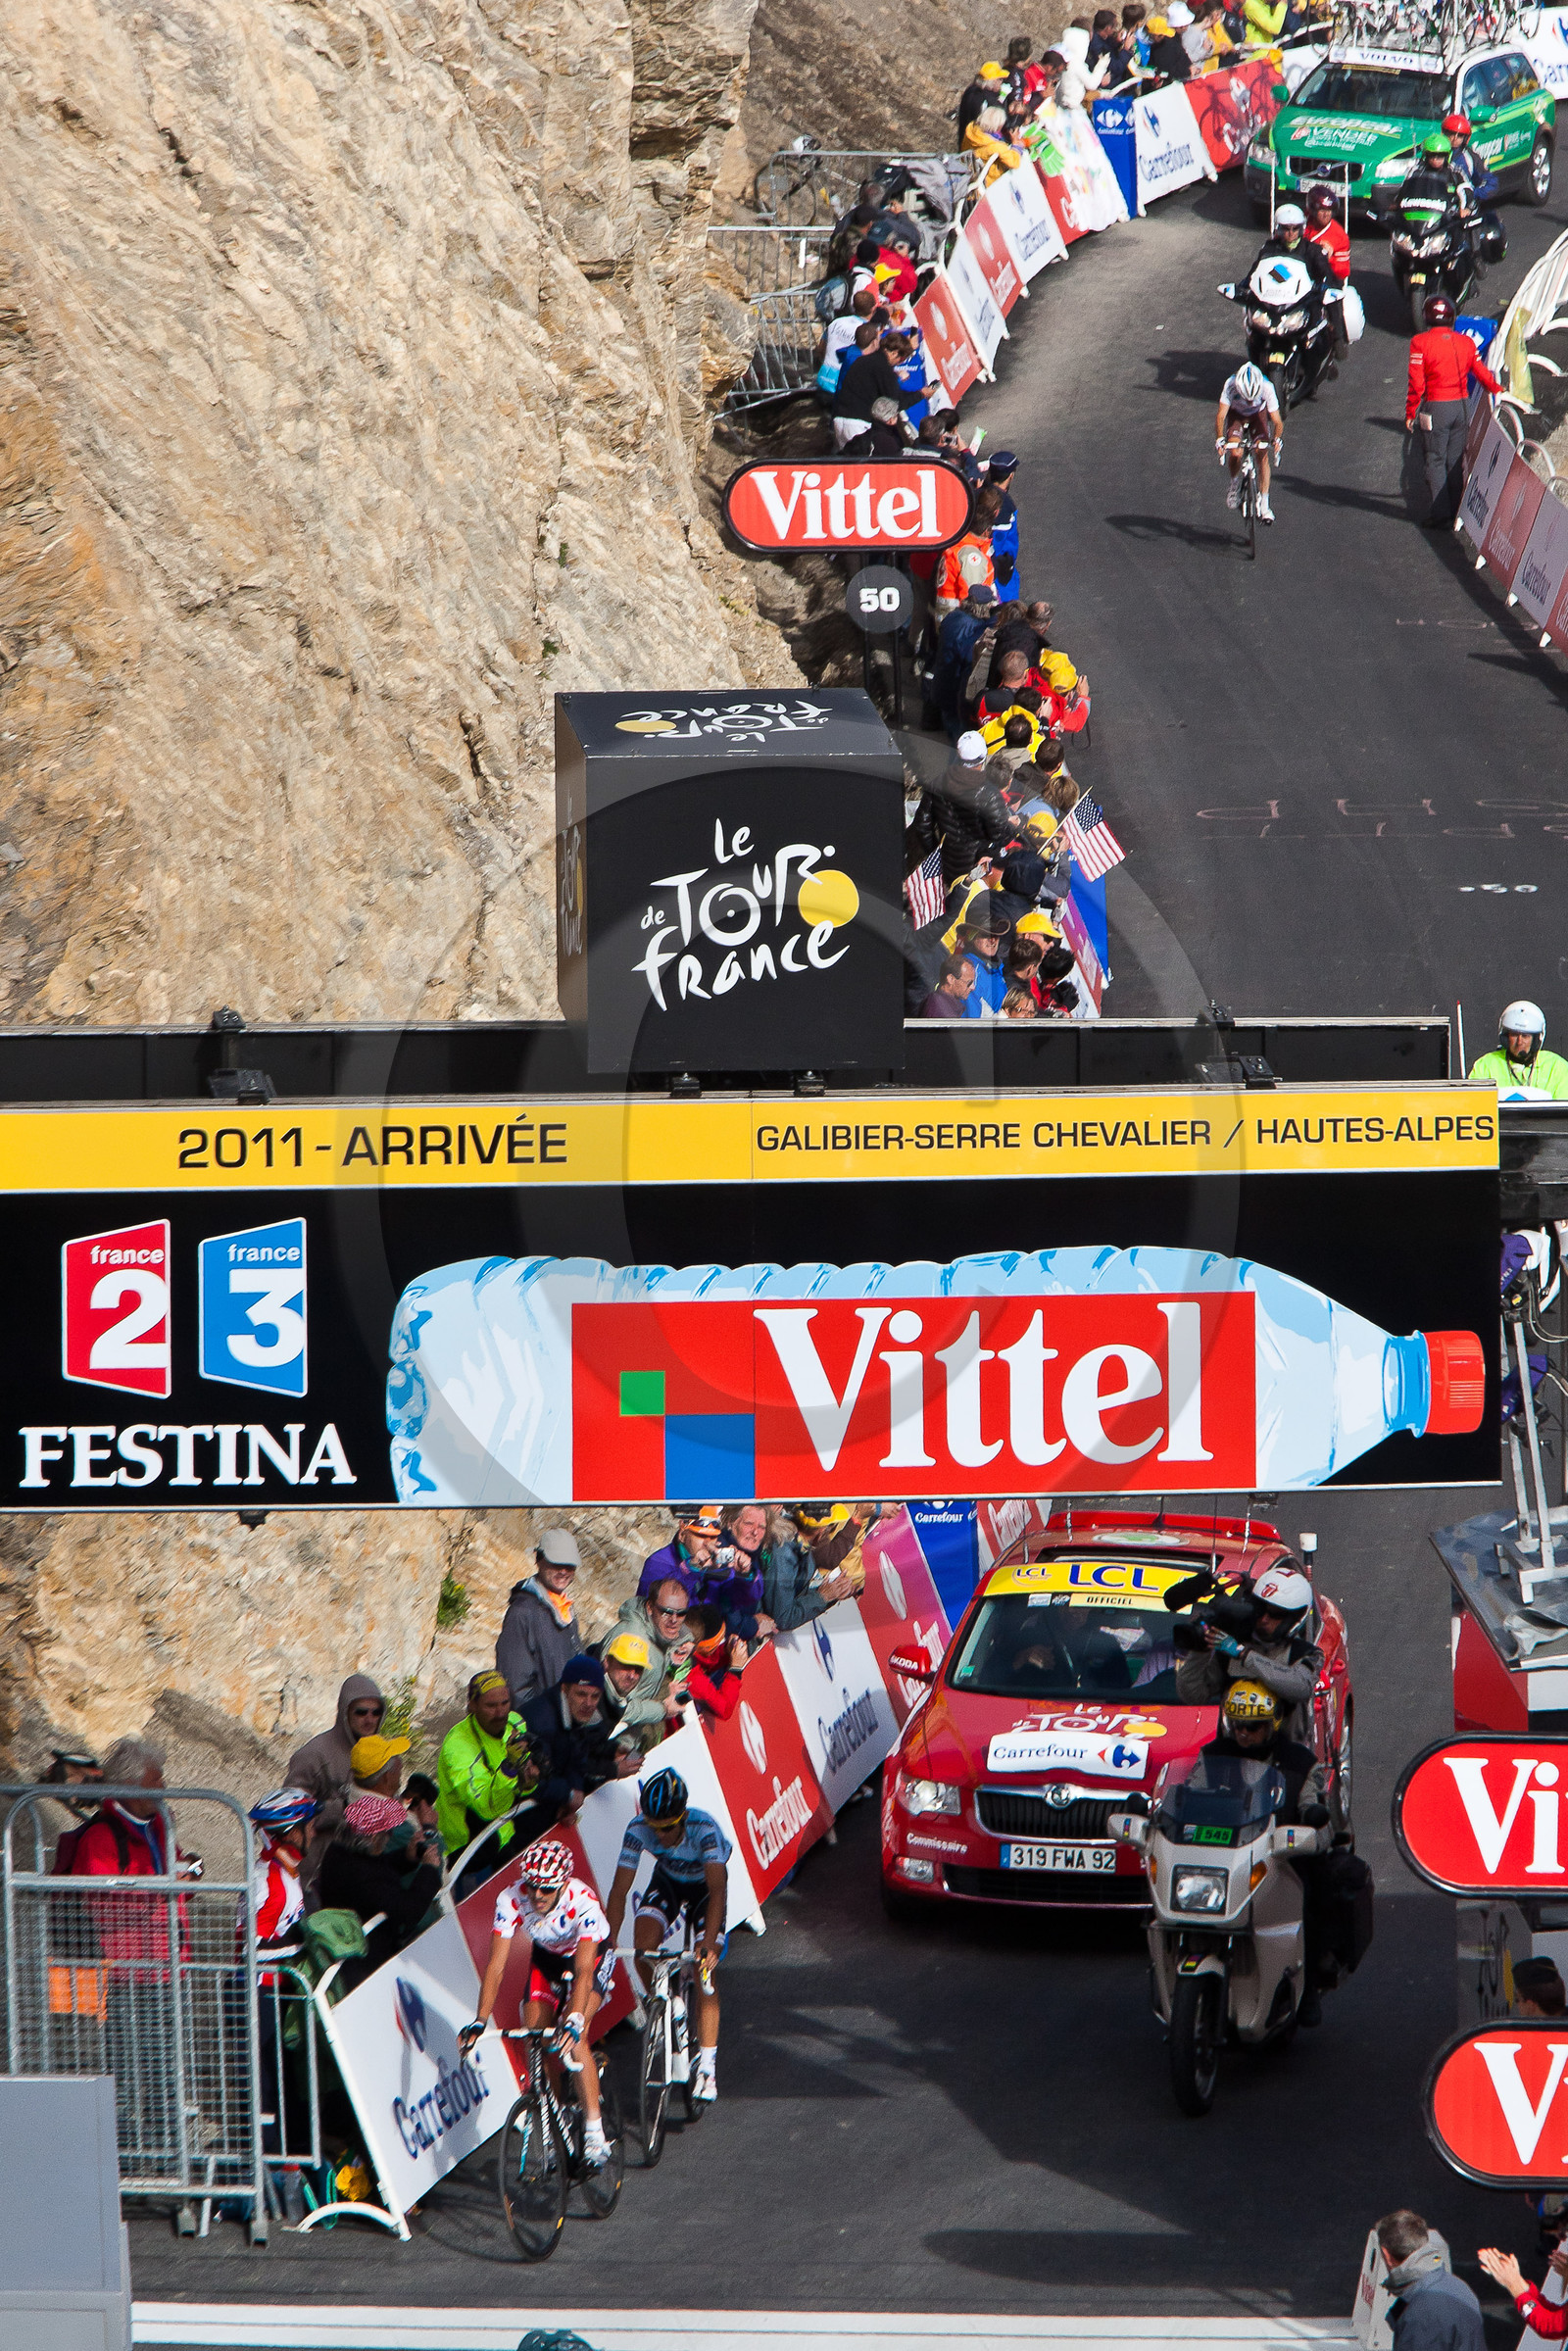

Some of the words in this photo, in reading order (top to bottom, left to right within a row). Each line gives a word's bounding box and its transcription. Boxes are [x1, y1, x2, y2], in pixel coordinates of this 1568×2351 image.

[1360, 53, 1413, 65] VOLVO
[1139, 141, 1195, 182] Carrefour
[1400, 197, 1447, 213] Kawasaki
[749, 469, 943, 540] Vittel
[858, 587, 901, 612] 50
[757, 1123, 1020, 1151] GALIBIER-SERRE
[1033, 1120, 1210, 1148] CHEVALIER
[1257, 1115, 1494, 1145] HAUTES-ALPES
[90, 1245, 165, 1265] france
[227, 1242, 300, 1263] france
[89, 1269, 170, 1369] 2
[226, 1268, 305, 1368] 3
[754, 1301, 1214, 1472] Vittel
[18, 1423, 358, 1488] FESTINA
[914, 1511, 963, 1524] Carrefour
[1069, 1563, 1159, 1591] LCL
[1086, 1596, 1134, 1605] OFFICIEL
[993, 1743, 1088, 1759] Carrefour
[746, 1776, 813, 1870] Carrefour
[1443, 1756, 1568, 1875] Vi
[906, 1832, 967, 1854] Commissaire
[1014, 1846, 1047, 1867] 319
[1053, 1847, 1086, 1869] FWA
[1093, 1850, 1115, 1870] 92
[392, 2055, 489, 2160] Carrefour
[1473, 2041, 1568, 2166] V
